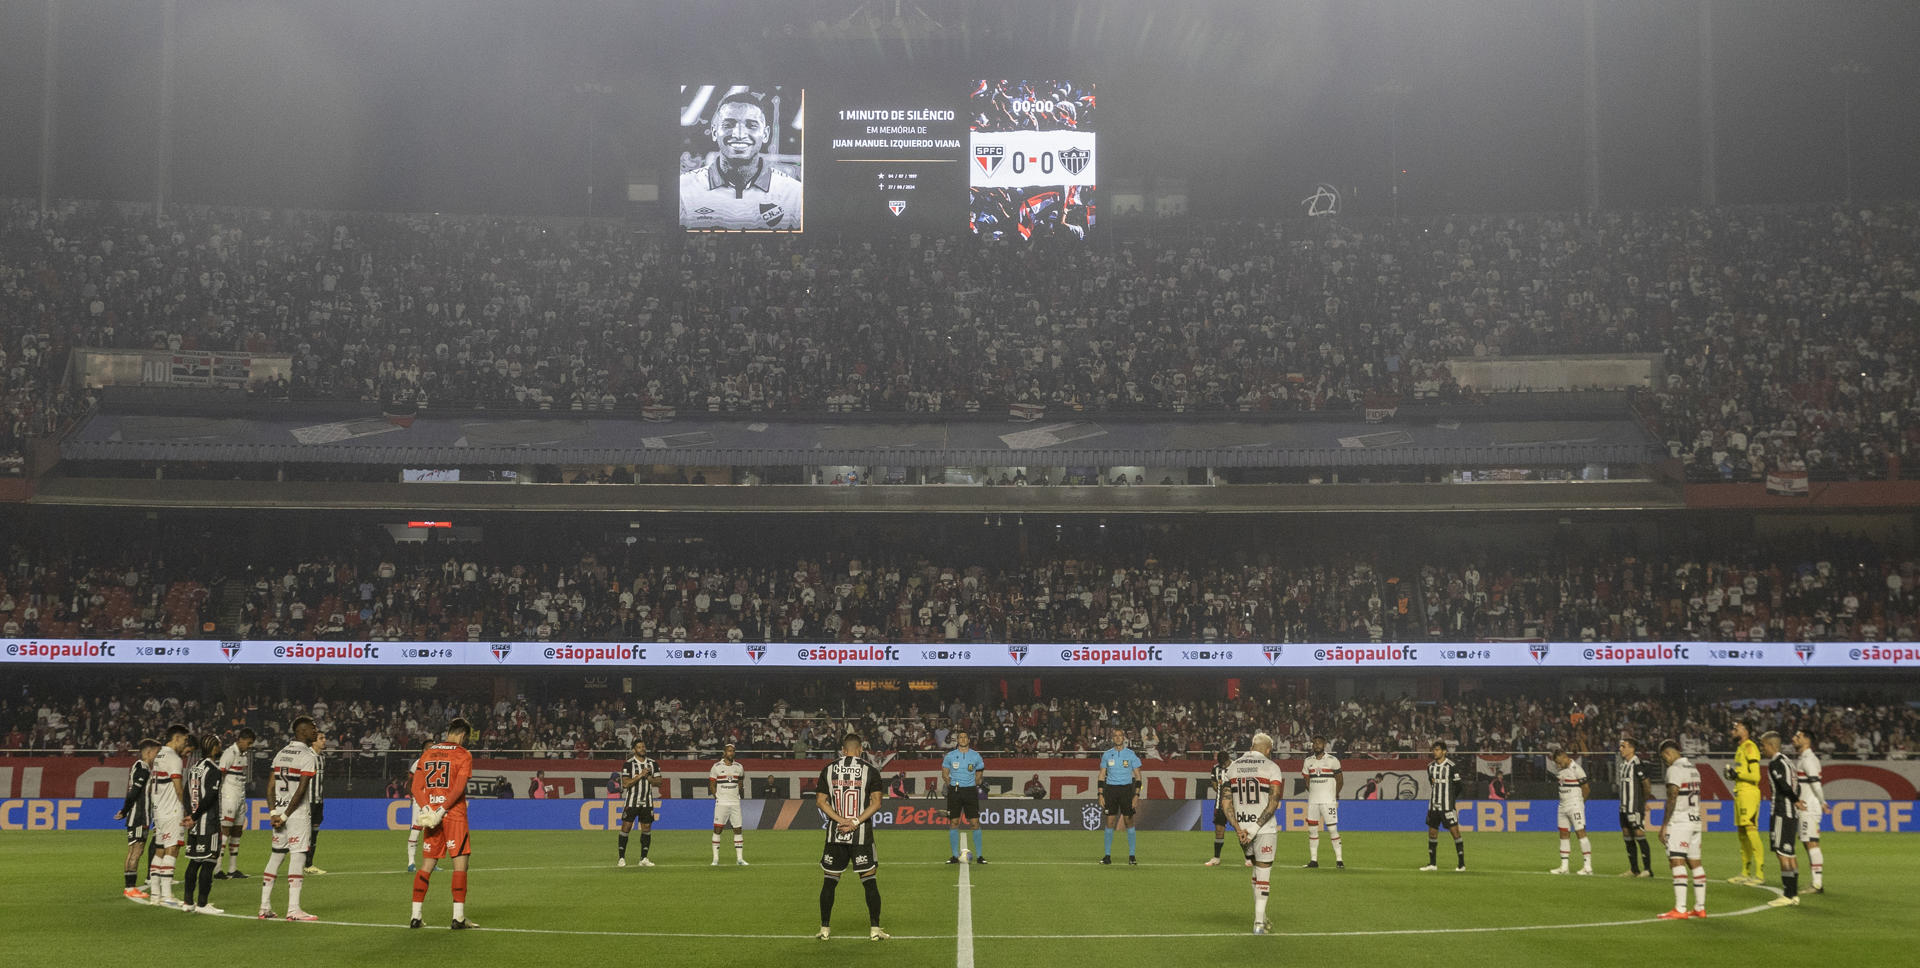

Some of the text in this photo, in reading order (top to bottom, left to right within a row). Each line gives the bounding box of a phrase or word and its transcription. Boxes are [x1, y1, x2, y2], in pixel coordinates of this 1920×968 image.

[838, 108, 955, 121] 1 MINUTO DE SILÊNCIO
[1012, 100, 1054, 113] 00:00
[866, 124, 927, 134] EM MEMÓRIA DE
[832, 139, 961, 149] JUAN MANUEL IZQUIERDO VIANA
[976, 147, 1003, 155] SPFC
[1012, 151, 1025, 174] 0
[1041, 151, 1054, 174] 0
[7, 642, 115, 660] @sãopaulofc
[274, 642, 379, 662] @sãopaulofc
[544, 645, 646, 664] @sãopaulofc
[798, 645, 899, 665] @sãopaulofc
[1061, 645, 1162, 665] @sãopaulofc
[1315, 645, 1414, 664] @sãopaulofc
[1583, 645, 1689, 664] @sãopaulofc
[280, 766, 289, 792] 5
[424, 761, 450, 789] 23
[841, 767, 861, 777] bmg
[1237, 777, 1260, 804] 10
[834, 789, 859, 819] 10
[0, 799, 83, 831] CBF
[979, 808, 1000, 825] do
[1003, 808, 1070, 825] BRASIL
[1236, 811, 1257, 823] blue
[1454, 801, 1531, 832] CBF
[1574, 813, 1582, 821] 13
[1645, 801, 1722, 832] CF
[1832, 801, 1914, 832] CBF
